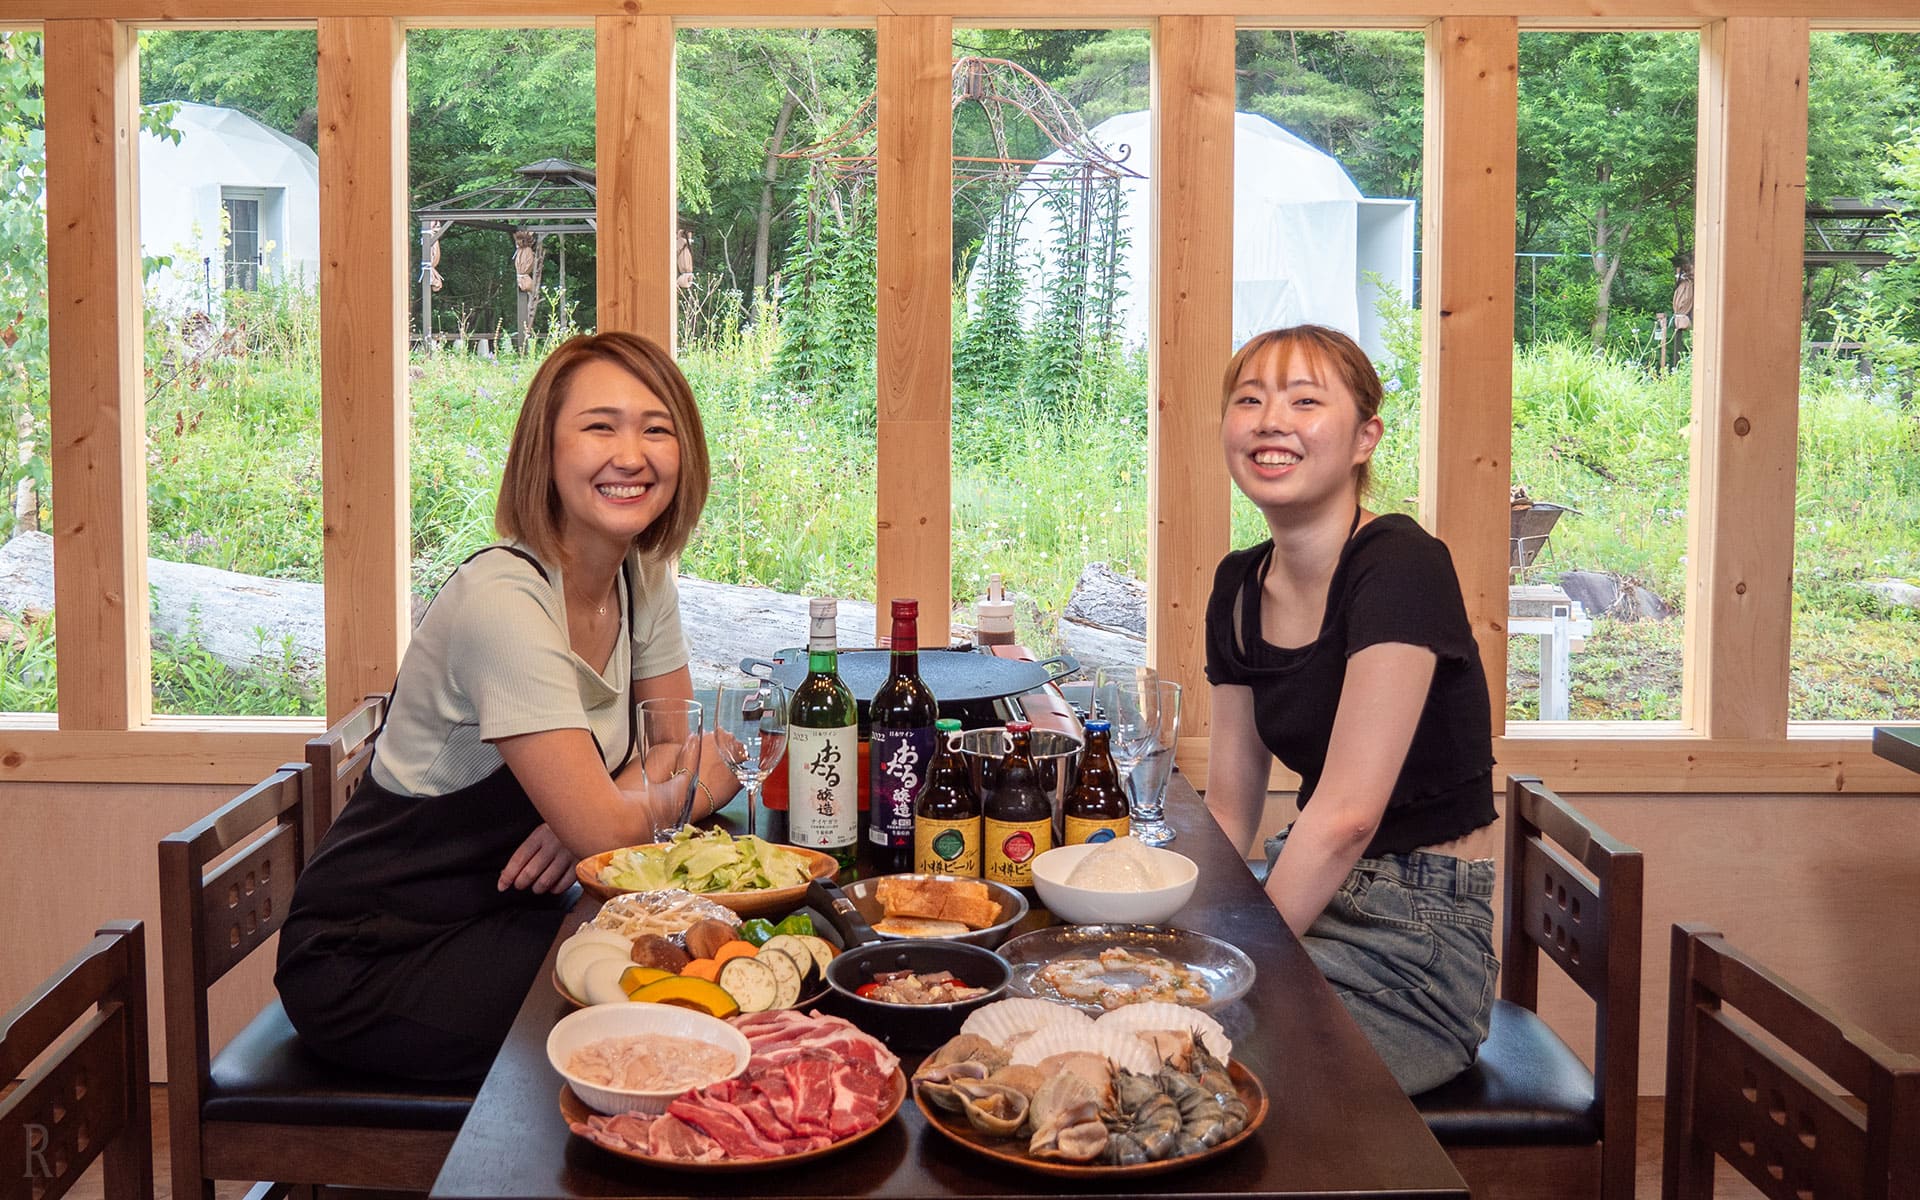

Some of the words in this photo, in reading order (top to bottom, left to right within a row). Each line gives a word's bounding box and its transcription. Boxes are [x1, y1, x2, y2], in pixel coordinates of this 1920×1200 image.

[871, 731, 886, 742] 2022
[990, 861, 1032, 878] 小樽ビー
